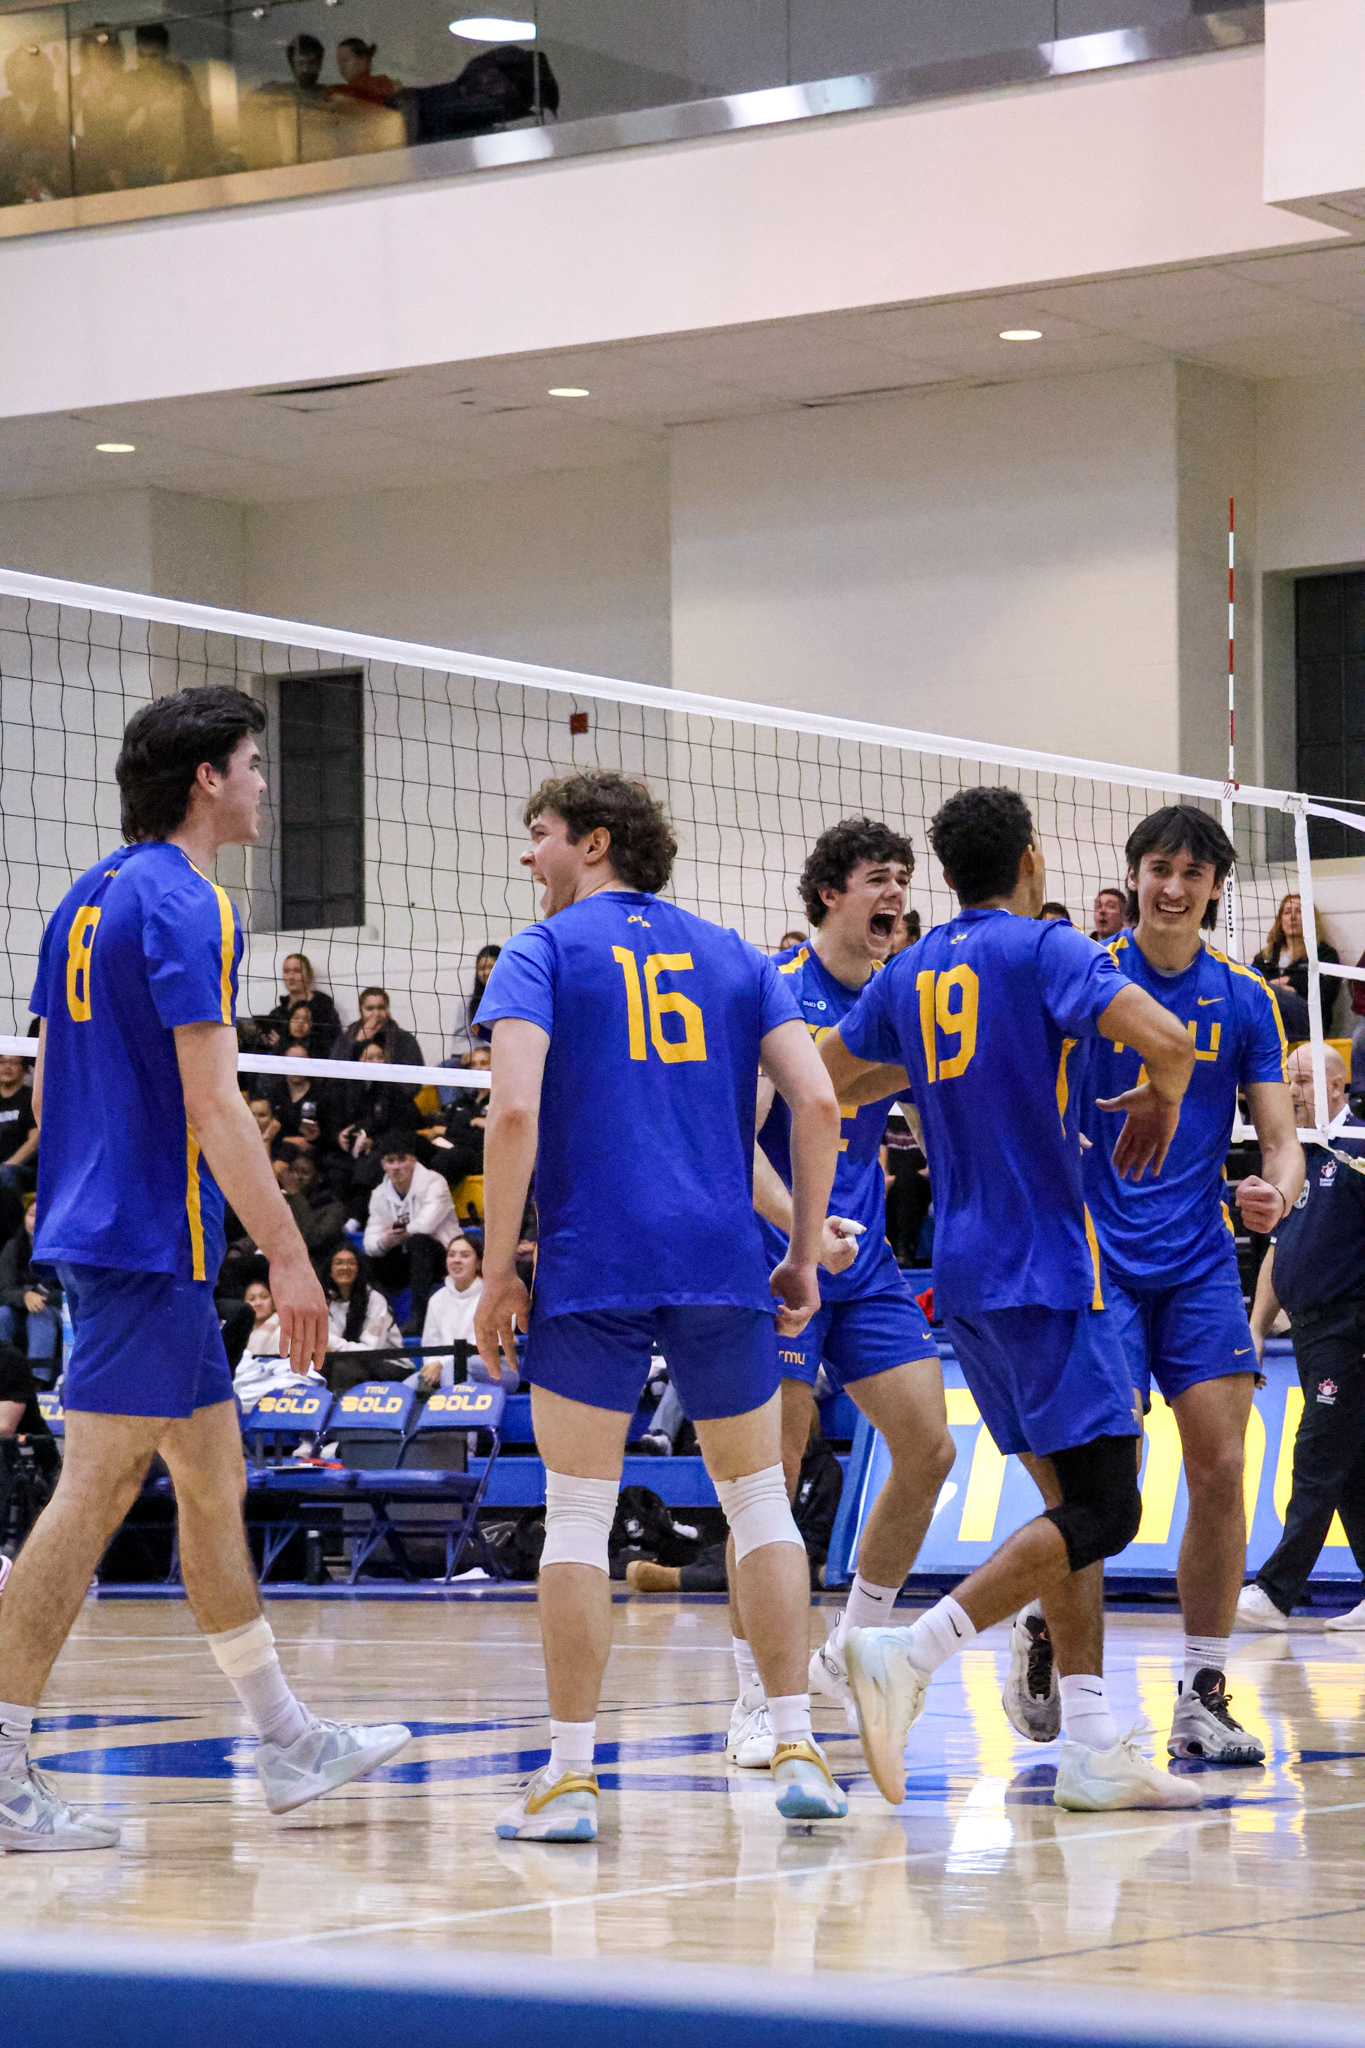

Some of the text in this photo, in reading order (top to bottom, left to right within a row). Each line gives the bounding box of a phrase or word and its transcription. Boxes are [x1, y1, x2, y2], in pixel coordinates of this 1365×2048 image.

[66, 905, 102, 1023] 8
[611, 945, 708, 1064] 16
[915, 963, 980, 1084] 19
[258, 1396, 320, 1414] BOLD
[340, 1395, 403, 1413] BOLD
[427, 1394, 492, 1411] BOLD
